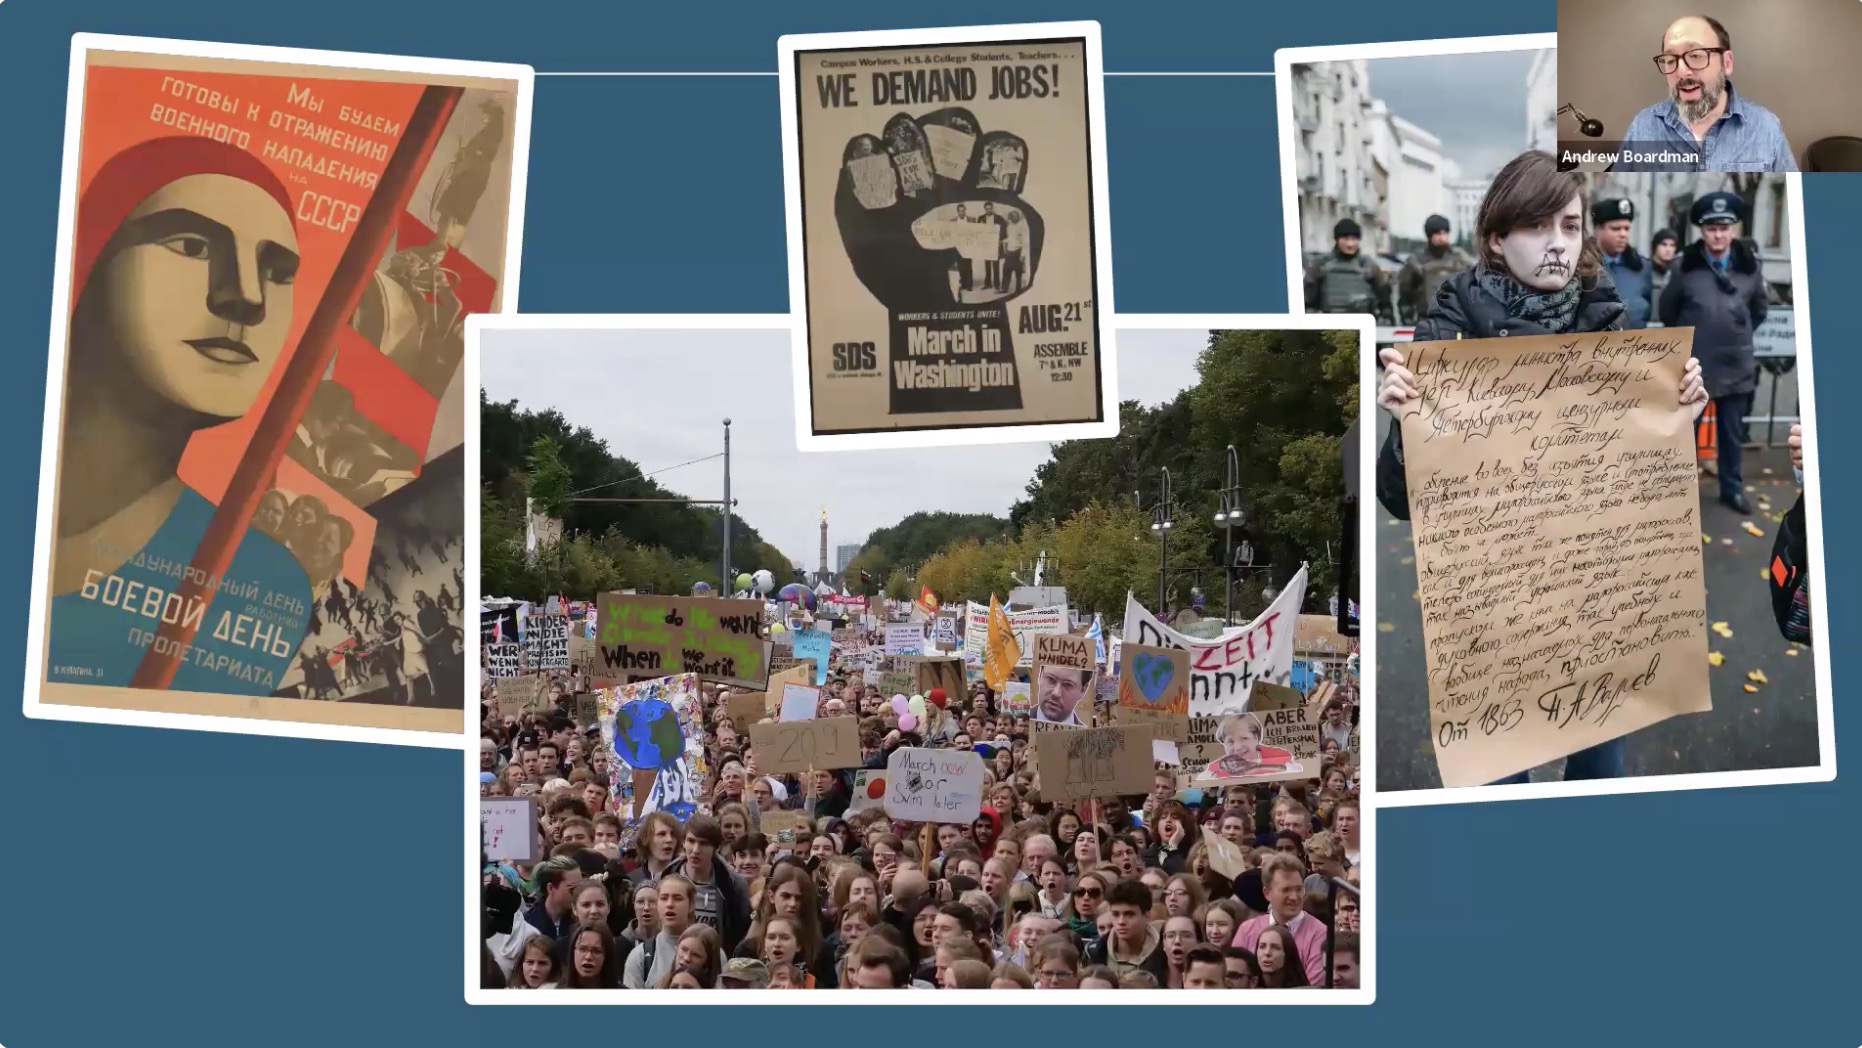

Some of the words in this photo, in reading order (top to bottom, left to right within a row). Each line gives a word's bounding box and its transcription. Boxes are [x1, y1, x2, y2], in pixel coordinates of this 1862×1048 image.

[820, 58, 857, 69] Campus
[859, 57, 901, 67] Workers,
[933, 53, 967, 64] College
[971, 51, 1013, 62] Students,
[816, 73, 858, 109] WE
[872, 66, 977, 106] DEMAND
[988, 63, 1060, 100] JOBS!
[160, 75, 240, 114] ГОТОВЫ
[246, 102, 261, 122] К
[268, 110, 389, 162] ОТРАЖЕНИЮ
[338, 105, 401, 138] БУДЕМ
[149, 102, 252, 150] ВОЕННОГО
[262, 140, 379, 191] НАПАДЕНИЯ
[296, 190, 361, 234] СССР
[898, 311, 931, 321] WORKERS
[932, 311, 939, 320] &
[940, 310, 975, 321] STUDENTS
[977, 310, 1001, 320] UNITE!
[1018, 304, 1069, 334] AUG.
[908, 325, 977, 356] March
[982, 324, 1001, 353] in
[832, 341, 877, 371] SDS
[1033, 342, 1088, 358] ASSEMBLE
[1068, 358, 1082, 367] NW
[894, 359, 1014, 392] Washington
[1051, 372, 1073, 382] 12:30
[1635, 369, 1654, 381] и
[263, 590, 305, 616] ДЕНЬ
[1669, 590, 1682, 599] и
[80, 569, 206, 632] БОЕВОЙ
[213, 610, 291, 658] ДЕНЬ
[525, 615, 568, 629] KINDER
[664, 608, 684, 627] do
[720, 612, 763, 639] want
[543, 628, 565, 638] DIE
[1192, 612, 1281, 671] ZEIT
[488, 645, 518, 657] WER
[526, 639, 568, 649] MACHT
[1039, 636, 1088, 657] KLIMA
[127, 627, 274, 689] ПРОЛЕТАРИАТА
[488, 657, 519, 667] WENN
[600, 645, 661, 669] When
[681, 648, 705, 663] we
[1038, 653, 1089, 669] WANDEL?
[488, 668, 519, 677] NICHT
[1264, 706, 1307, 727] ABER
[1439, 717, 1472, 747] От
[1477, 699, 1524, 735] 1863
[1189, 717, 1219, 735] LIMA
[1266, 726, 1283, 737] ICH
[1187, 734, 1219, 744] ANDEL
[900, 752, 936, 775] March
[940, 760, 970, 775] now
[1182, 758, 1210, 770] SCHON
[1294, 751, 1318, 760] STEAK
[925, 778, 948, 790] or
[933, 794, 962, 811] later
